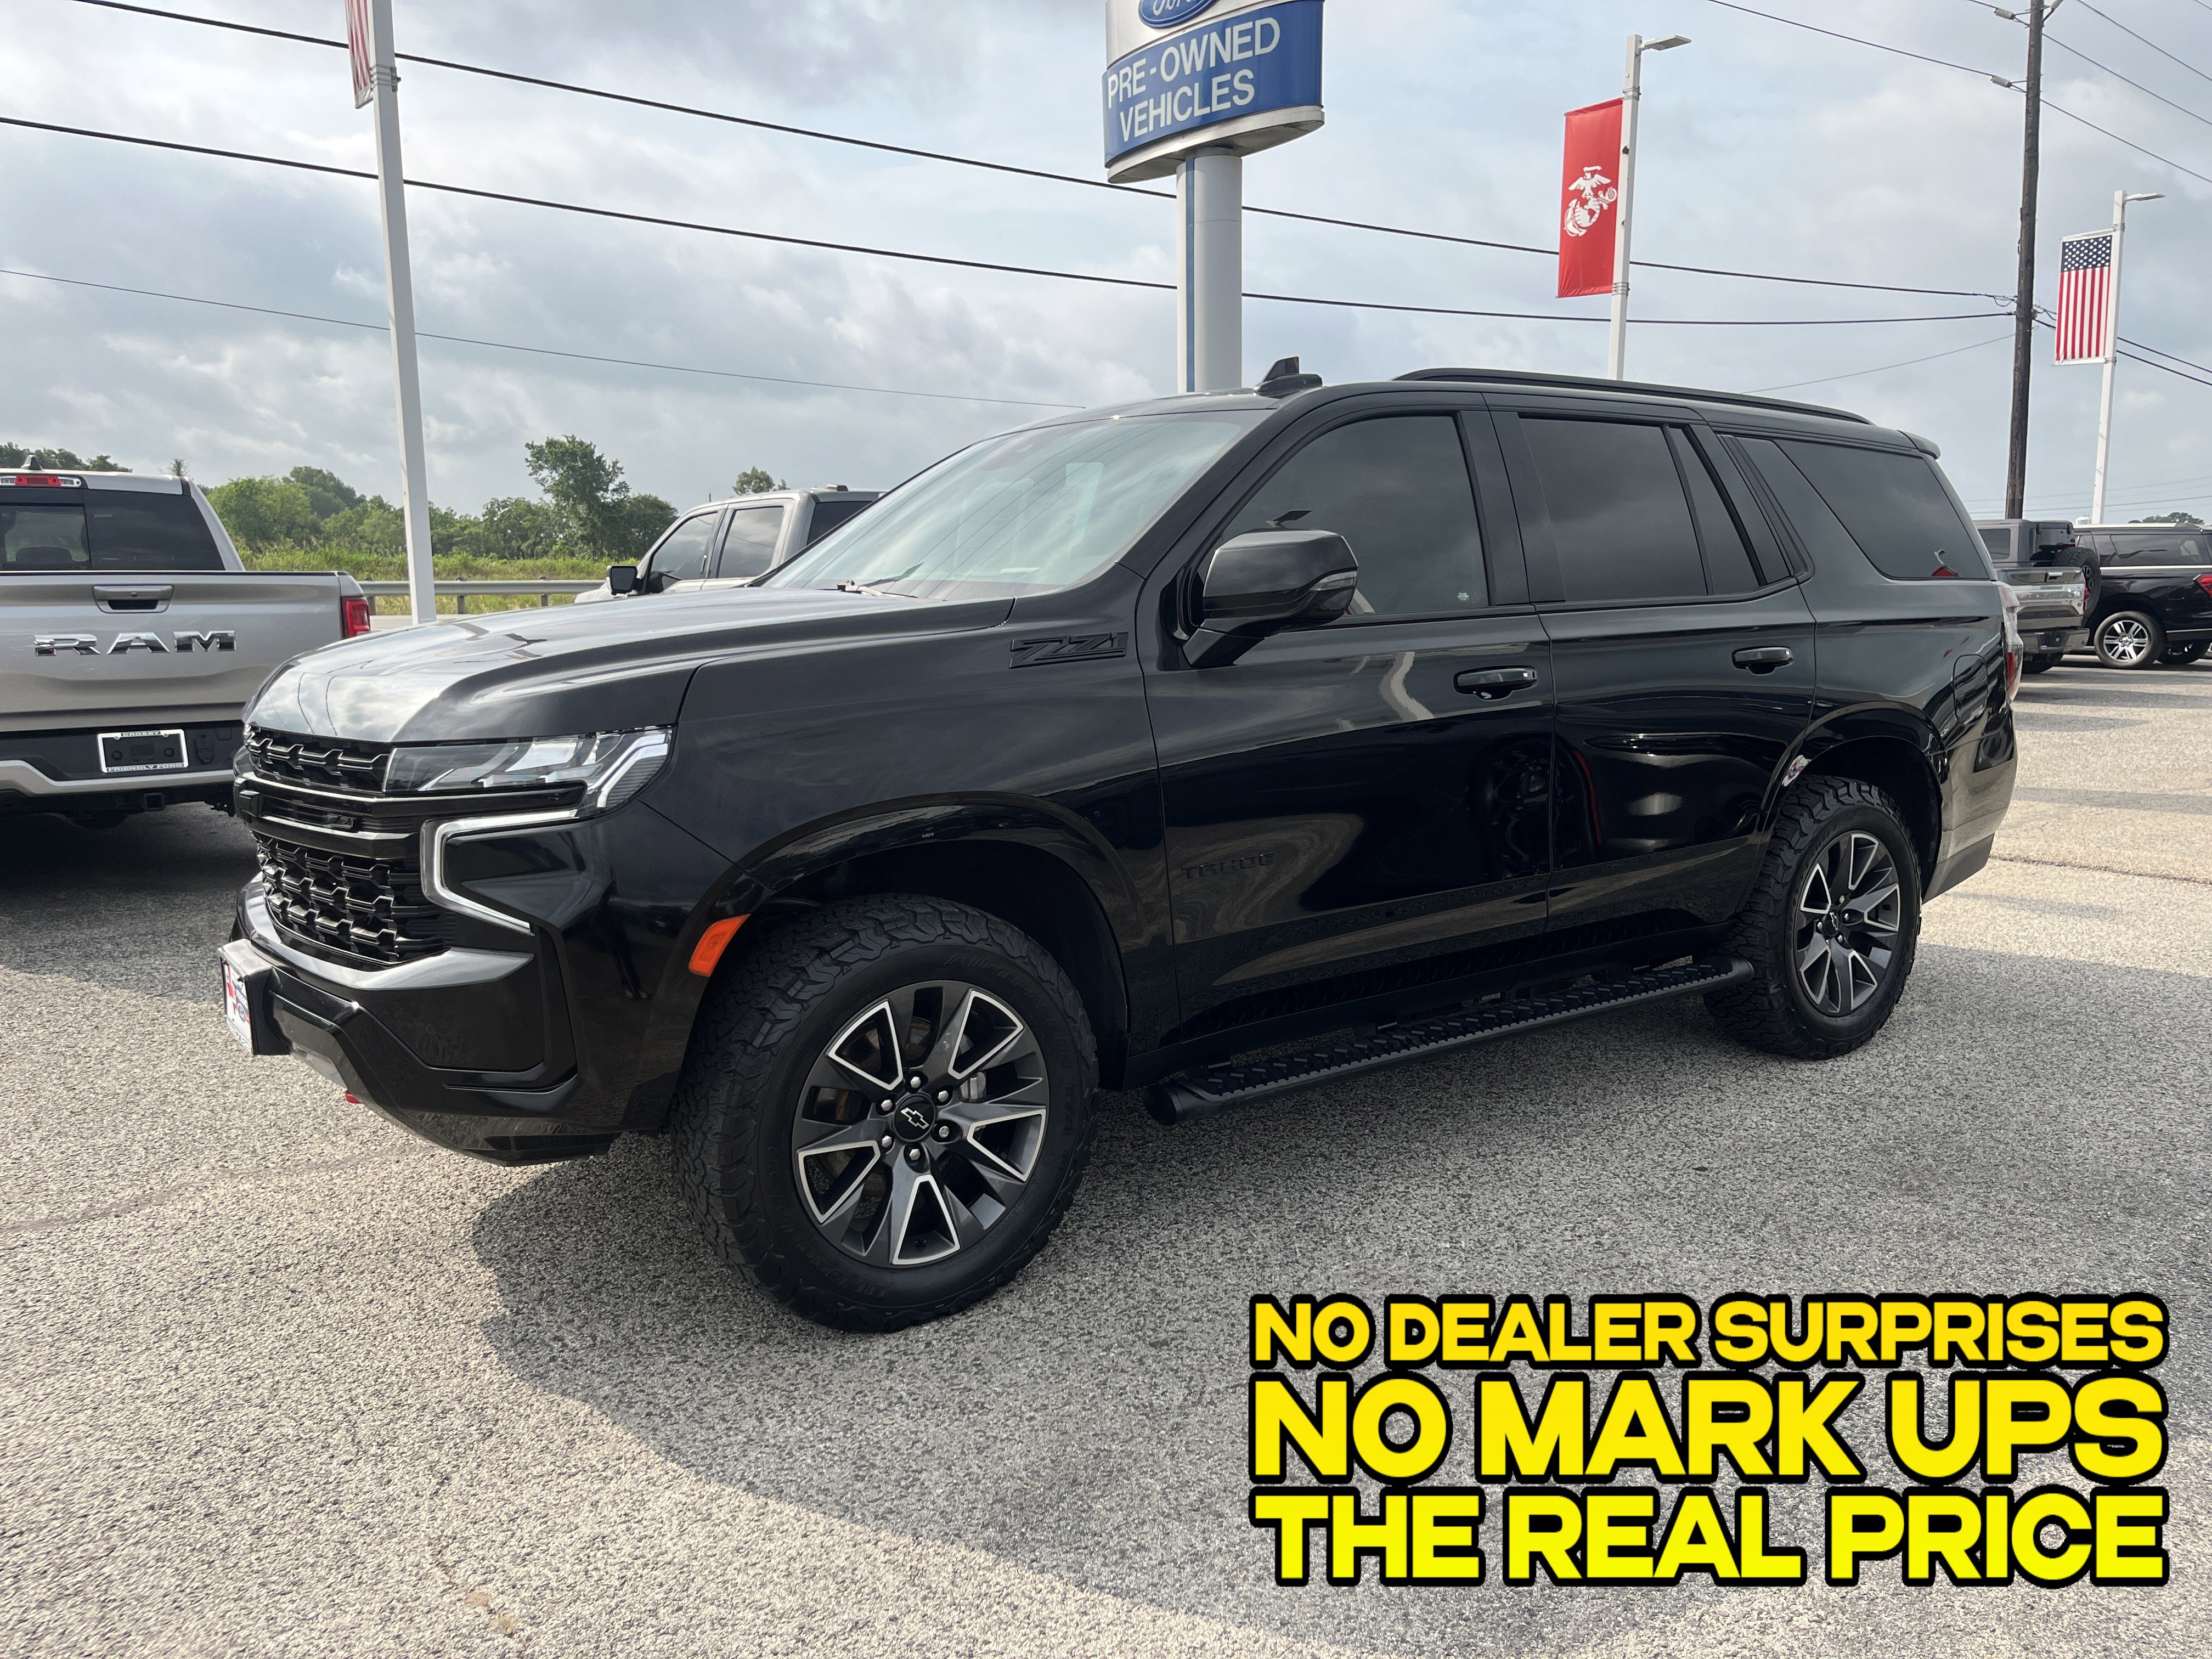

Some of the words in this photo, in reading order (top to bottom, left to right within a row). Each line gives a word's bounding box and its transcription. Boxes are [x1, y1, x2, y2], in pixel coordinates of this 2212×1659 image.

[1107, 17, 1281, 109] PRE-OWNED
[1119, 69, 1255, 142] VEHICLES
[34, 630, 236, 656] RAM
[1009, 631, 1129, 669] Z71
[1180, 851, 1276, 879] TAHOE
